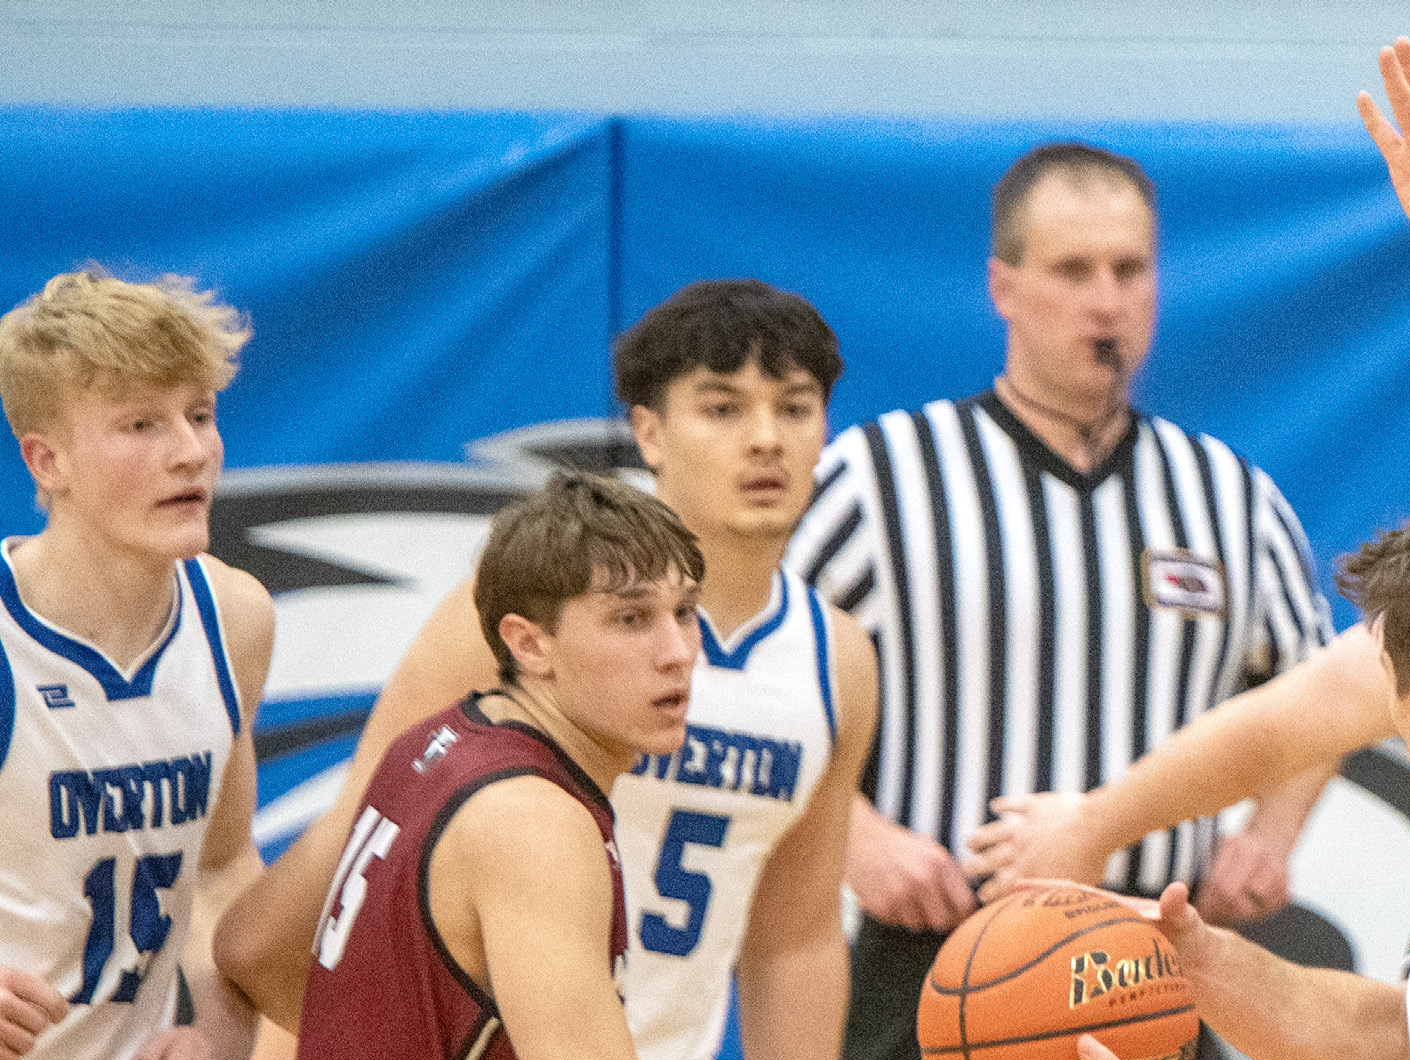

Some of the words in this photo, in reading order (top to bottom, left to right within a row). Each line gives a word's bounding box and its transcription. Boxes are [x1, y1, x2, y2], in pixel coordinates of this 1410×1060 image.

[49, 751, 213, 839] OVERTON
[68, 851, 183, 1004] 15
[638, 809, 731, 957] 5
